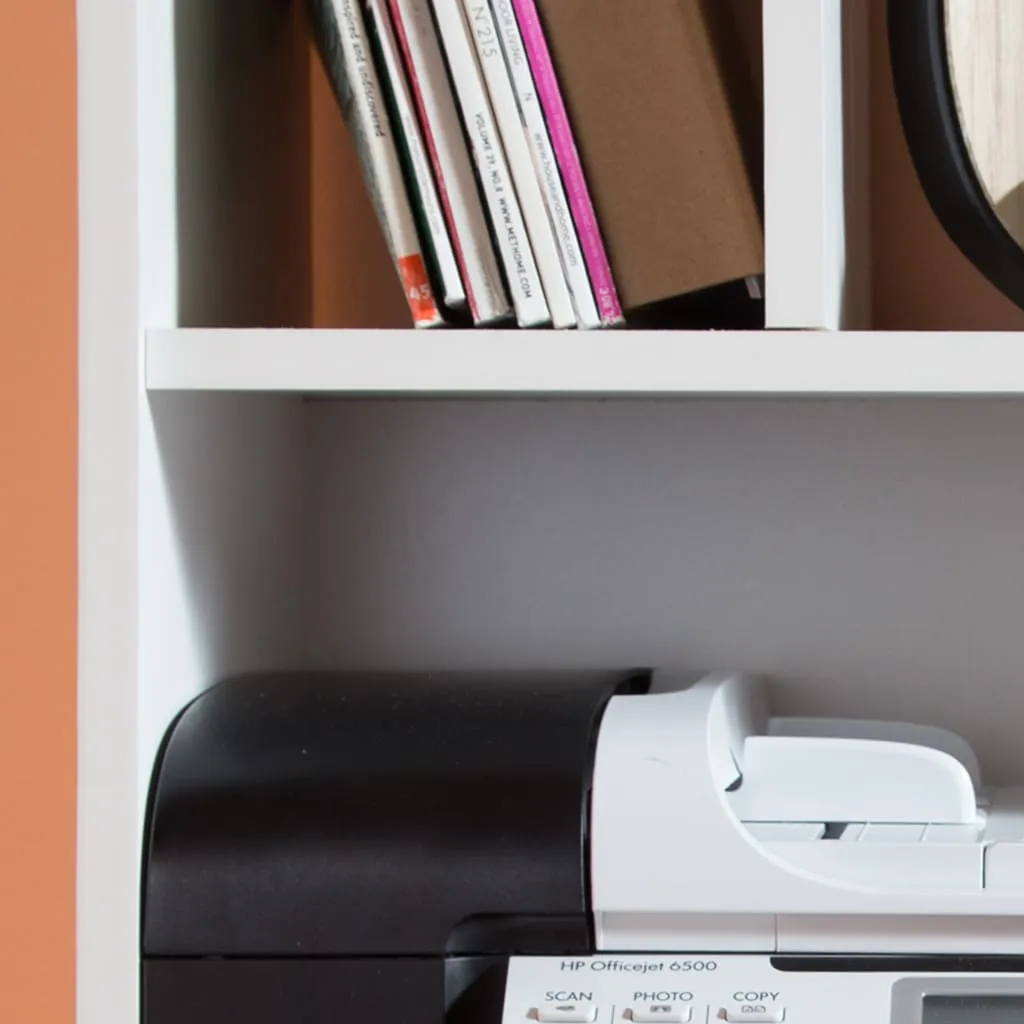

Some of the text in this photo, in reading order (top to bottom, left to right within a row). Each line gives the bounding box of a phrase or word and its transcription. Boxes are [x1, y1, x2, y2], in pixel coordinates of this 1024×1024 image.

[476, 26, 498, 57] 215
[475, 113, 493, 151] VOLUME
[560, 960, 718, 974] HP Officejet 6500
[545, 991, 593, 1001] SCAN
[633, 991, 694, 1001] PHOTO
[733, 991, 780, 1002] COPY
